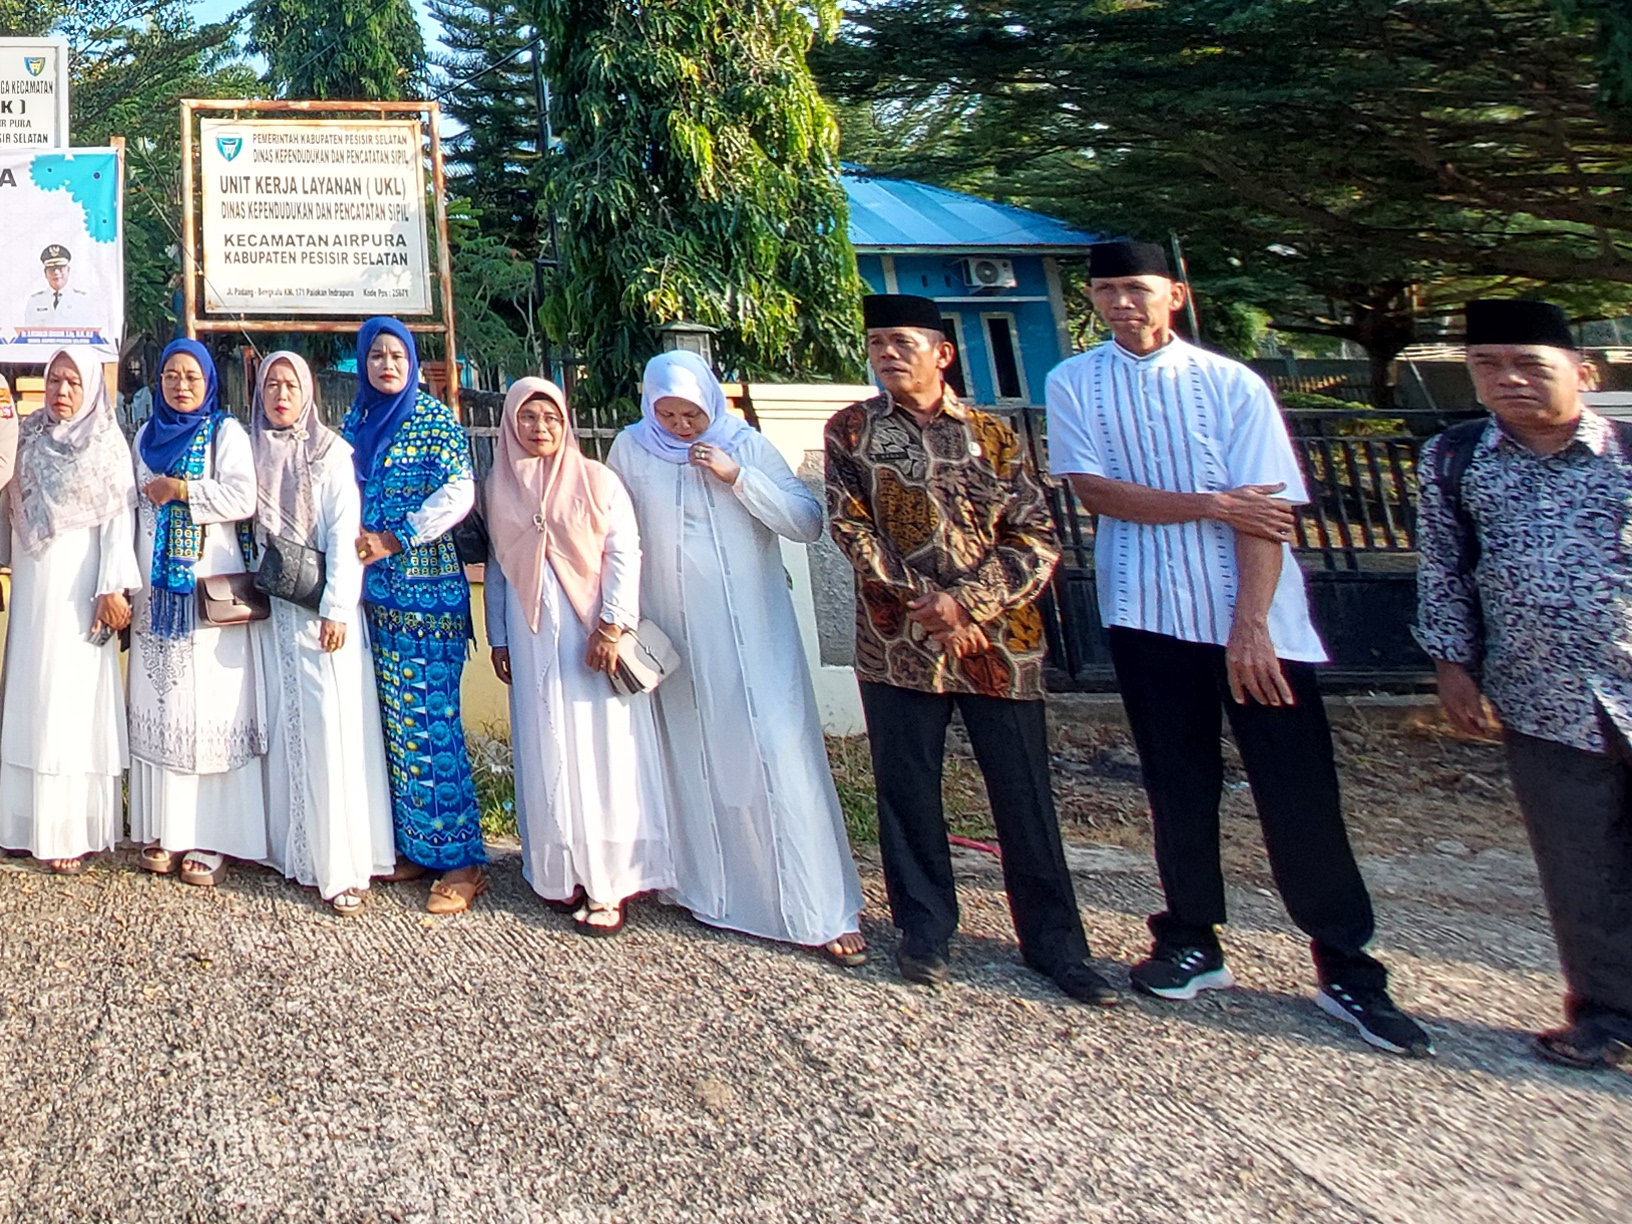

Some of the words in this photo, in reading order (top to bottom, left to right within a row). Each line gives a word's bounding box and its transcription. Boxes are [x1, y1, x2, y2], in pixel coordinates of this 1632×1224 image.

[11, 80, 53, 94] KECAMATAN
[9, 119, 32, 128] PURA
[13, 133, 48, 143] SELATAN
[253, 133, 299, 144] PEMERINTAH
[300, 134, 343, 145] KABUPATEN
[345, 134, 373, 145] PESISIR
[375, 134, 407, 145] SELATAN
[253, 149, 273, 164] DINAS
[275, 149, 330, 164] KEPENDUDUKAN
[331, 150, 345, 164] DAN
[347, 150, 390, 164] PENCATATAN
[391, 150, 409, 164] SIPIL
[220, 175, 251, 194] UNIT
[256, 176, 298, 195] KERJA
[302, 176, 362, 195] LAYANAN
[221, 201, 246, 219] DINAS
[248, 201, 314, 220] KEPENDUDUKAN
[316, 202, 332, 220] DAN
[334, 202, 386, 221] PENCATATAN
[389, 203, 409, 222] SIPIL
[224, 234, 329, 247] KECAMATAN
[333, 234, 407, 247] AIRPURA
[224, 251, 296, 265] KABUPATEN
[301, 252, 349, 265] PESISIR
[353, 252, 408, 266] SELATAN
